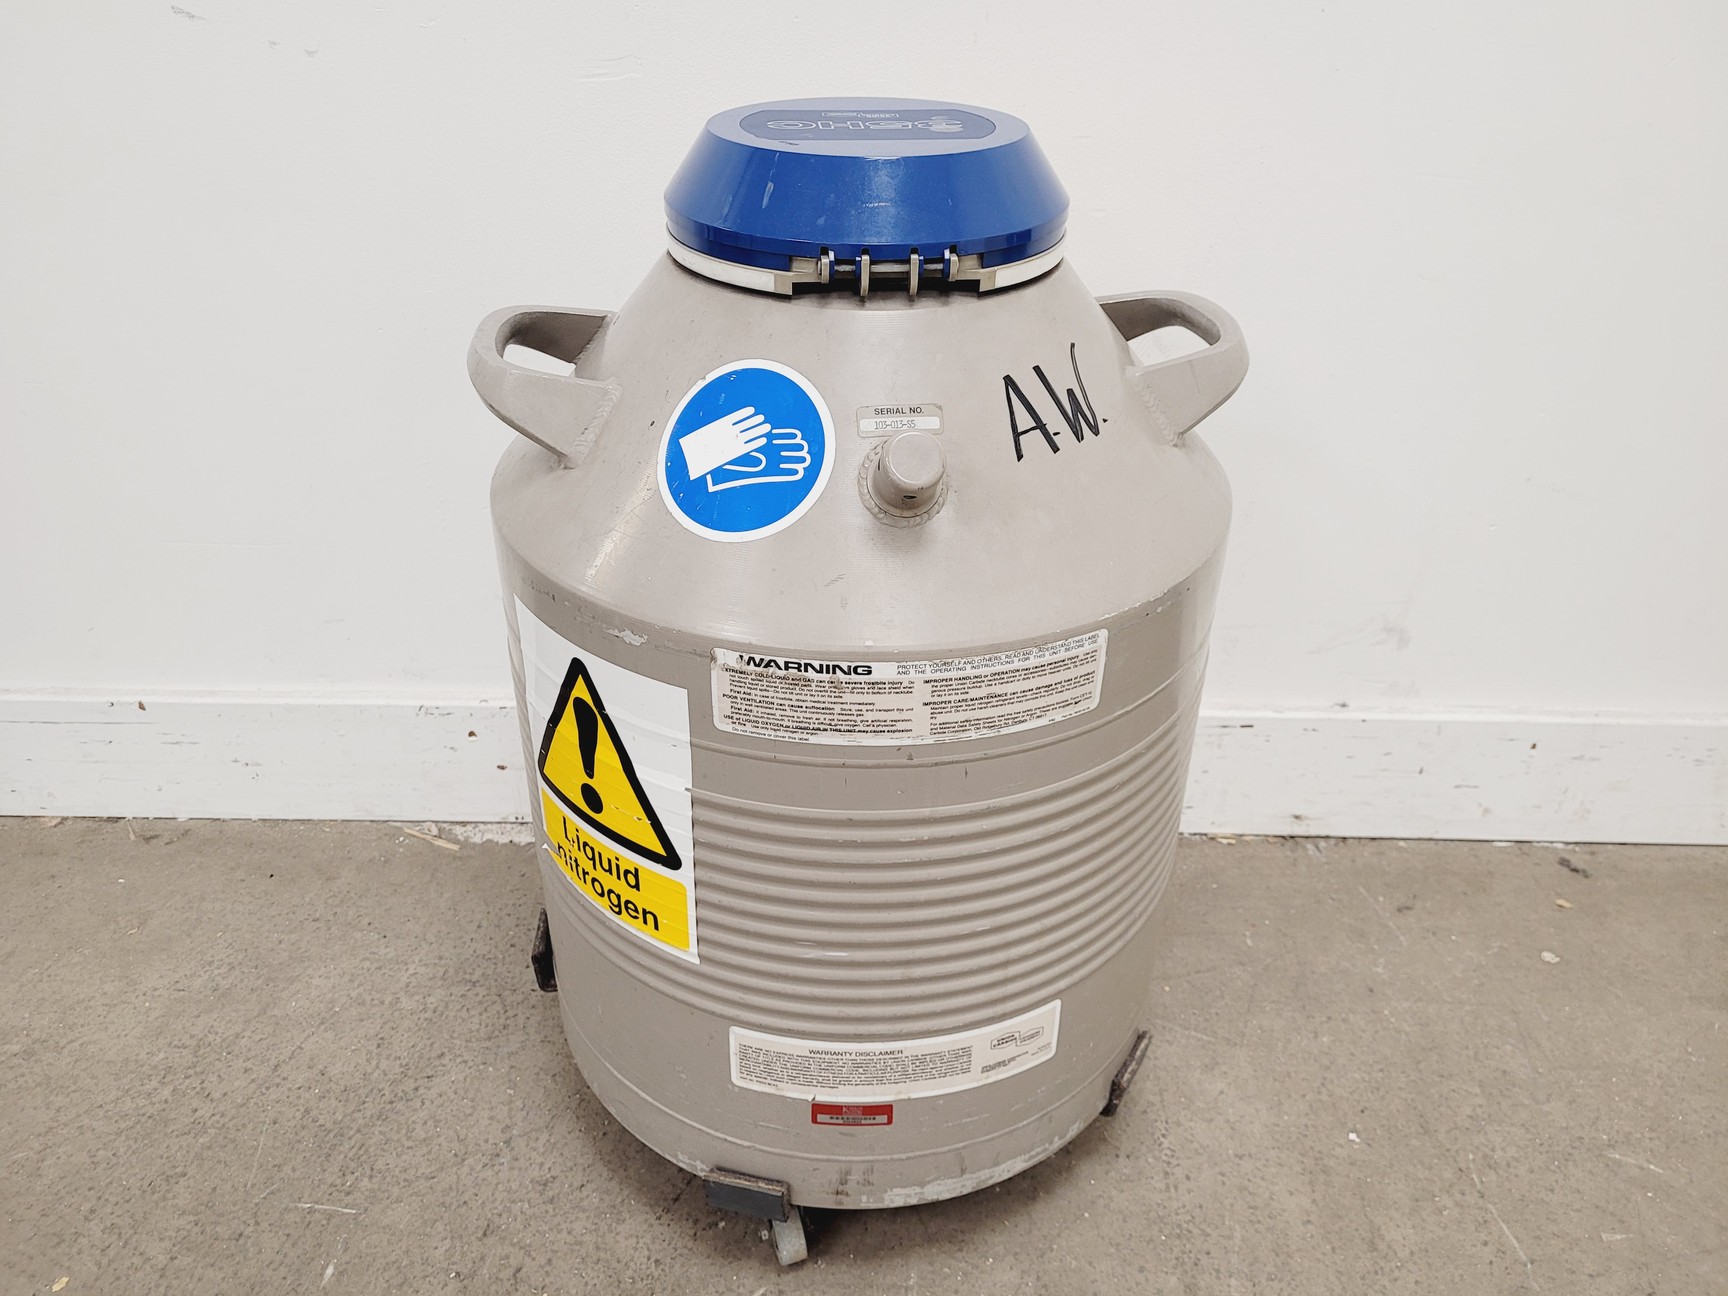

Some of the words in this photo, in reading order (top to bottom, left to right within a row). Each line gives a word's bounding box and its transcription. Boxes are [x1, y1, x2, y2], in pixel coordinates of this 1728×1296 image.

[874, 407, 907, 416] SERIAL
[909, 406, 924, 415] NO.
[930, 666, 967, 674] OPERATING
[971, 659, 1015, 670] INSTRUCTIONS
[1048, 649, 1061, 657] UNIT
[1064, 643, 1085, 653] BEFORE
[1005, 651, 1021, 660] READ
[1035, 642, 1071, 655] UNDERSTAND
[1072, 637, 1084, 645] THIS
[1085, 633, 1100, 641] LABEL
[739, 654, 873, 676] WARNING
[562, 815, 641, 892] Liquid
[556, 841, 660, 932] nitrogen
[808, 1049, 853, 1057] WARRANTY
[854, 1050, 904, 1058] DISCLAIMER
